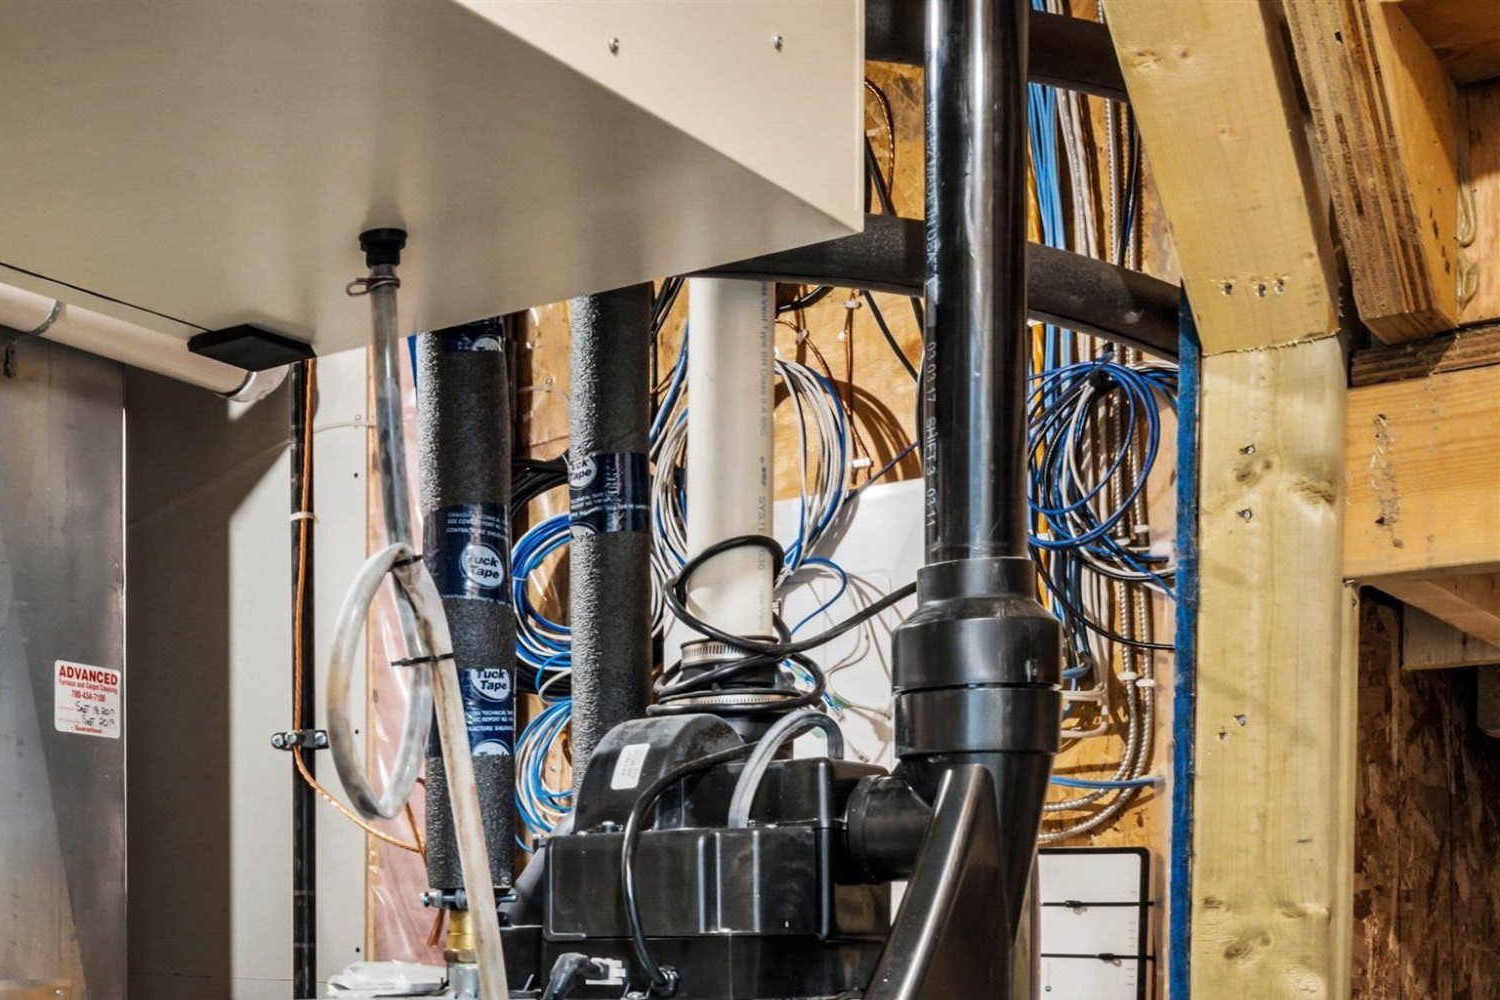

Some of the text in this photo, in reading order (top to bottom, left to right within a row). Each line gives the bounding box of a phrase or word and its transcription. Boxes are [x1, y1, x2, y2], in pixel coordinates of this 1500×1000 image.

[759, 325, 769, 348] Type
[925, 416, 938, 462] SHIFT
[758, 495, 768, 537] SYSTE
[59, 665, 118, 686] ADVANCED
[476, 668, 505, 679] Tuck
[480, 680, 507, 692] Tape
